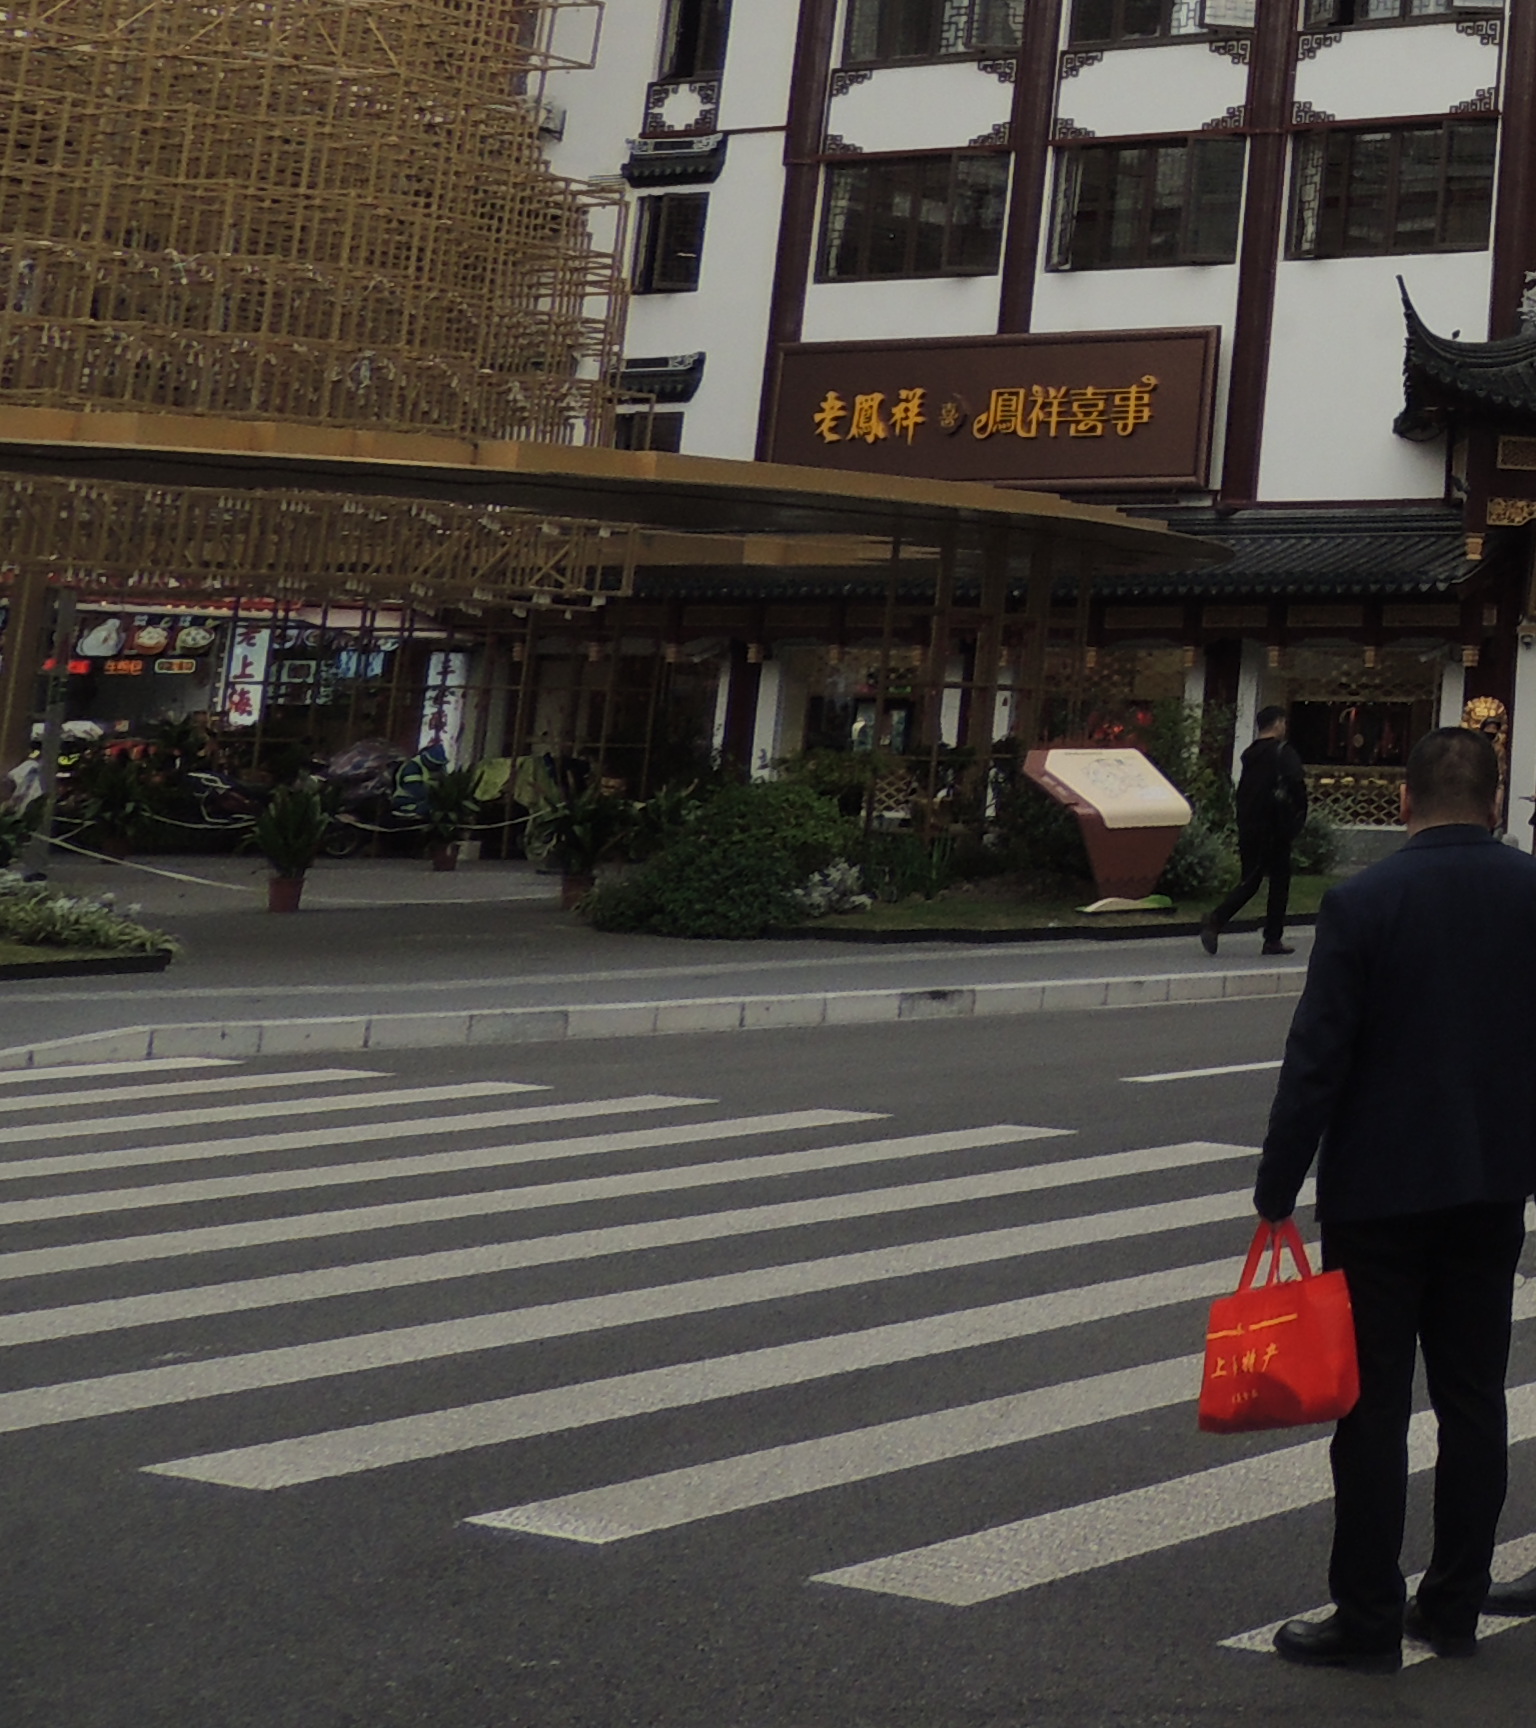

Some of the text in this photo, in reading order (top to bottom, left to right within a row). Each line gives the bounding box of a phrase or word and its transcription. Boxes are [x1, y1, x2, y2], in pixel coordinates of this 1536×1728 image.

[813, 388, 927, 446] 老鳳祥
[972, 374, 1158, 439] 鳳祥喜事
